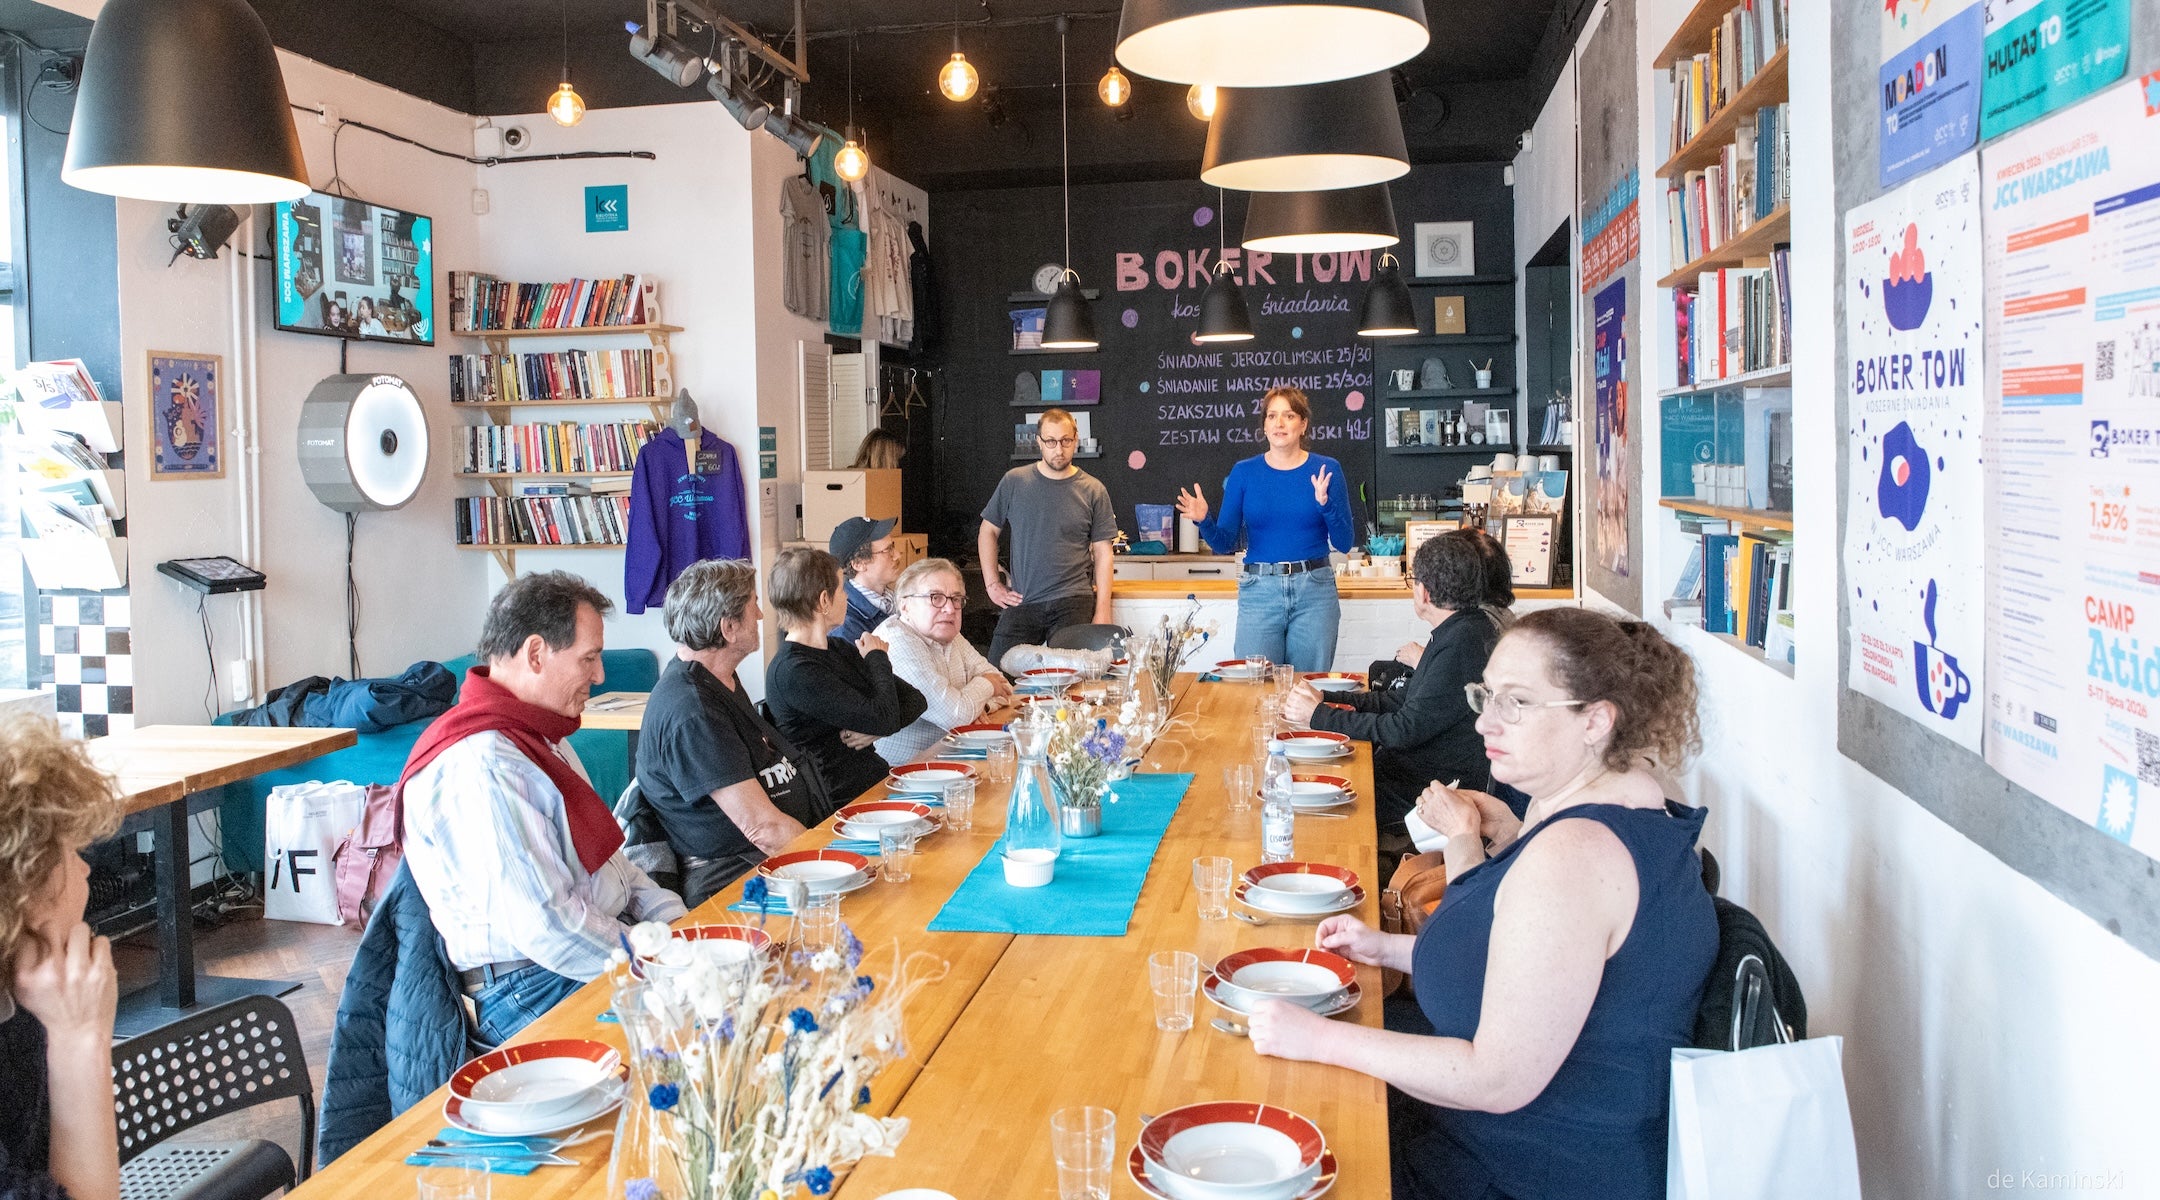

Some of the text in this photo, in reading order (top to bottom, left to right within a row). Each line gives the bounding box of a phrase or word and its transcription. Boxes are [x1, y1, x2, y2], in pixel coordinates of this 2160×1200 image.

[1988, 28, 2037, 79] HULTAJ
[2039, 15, 2061, 50] TO
[1885, 44, 1947, 111] MOADON
[1886, 113, 1899, 136] TO
[1993, 180, 2019, 211] JCC
[2021, 145, 2111, 201] WARSZAWA
[282, 212, 292, 304] JCC WARSZAWA
[1116, 247, 1276, 292] BOKER
[1260, 289, 1351, 316] śniadania
[1157, 343, 1372, 370] ŚNIADANIE JEROZOLIMSKIE 25/30
[1856, 353, 1914, 395] BOKER
[1922, 348, 1965, 390] TOW
[372, 375, 404, 388] FOTOMAT
[1157, 376, 1219, 395] ŚNIADANIE
[1226, 374, 1322, 393] WARSZAWSKIE
[1158, 403, 1245, 421] SZAKSZUKA
[1865, 395, 1950, 413] KOSZERNE ŚNIADANIA
[1159, 427, 1221, 446] ZESTAW
[2112, 428, 2151, 446] BOKER
[2089, 500, 2129, 532] 1,5%
[1895, 523, 1941, 562] WARSZAWA
[2084, 594, 2135, 634] CAMP
[2002, 723, 2059, 760] WARSZAWA
